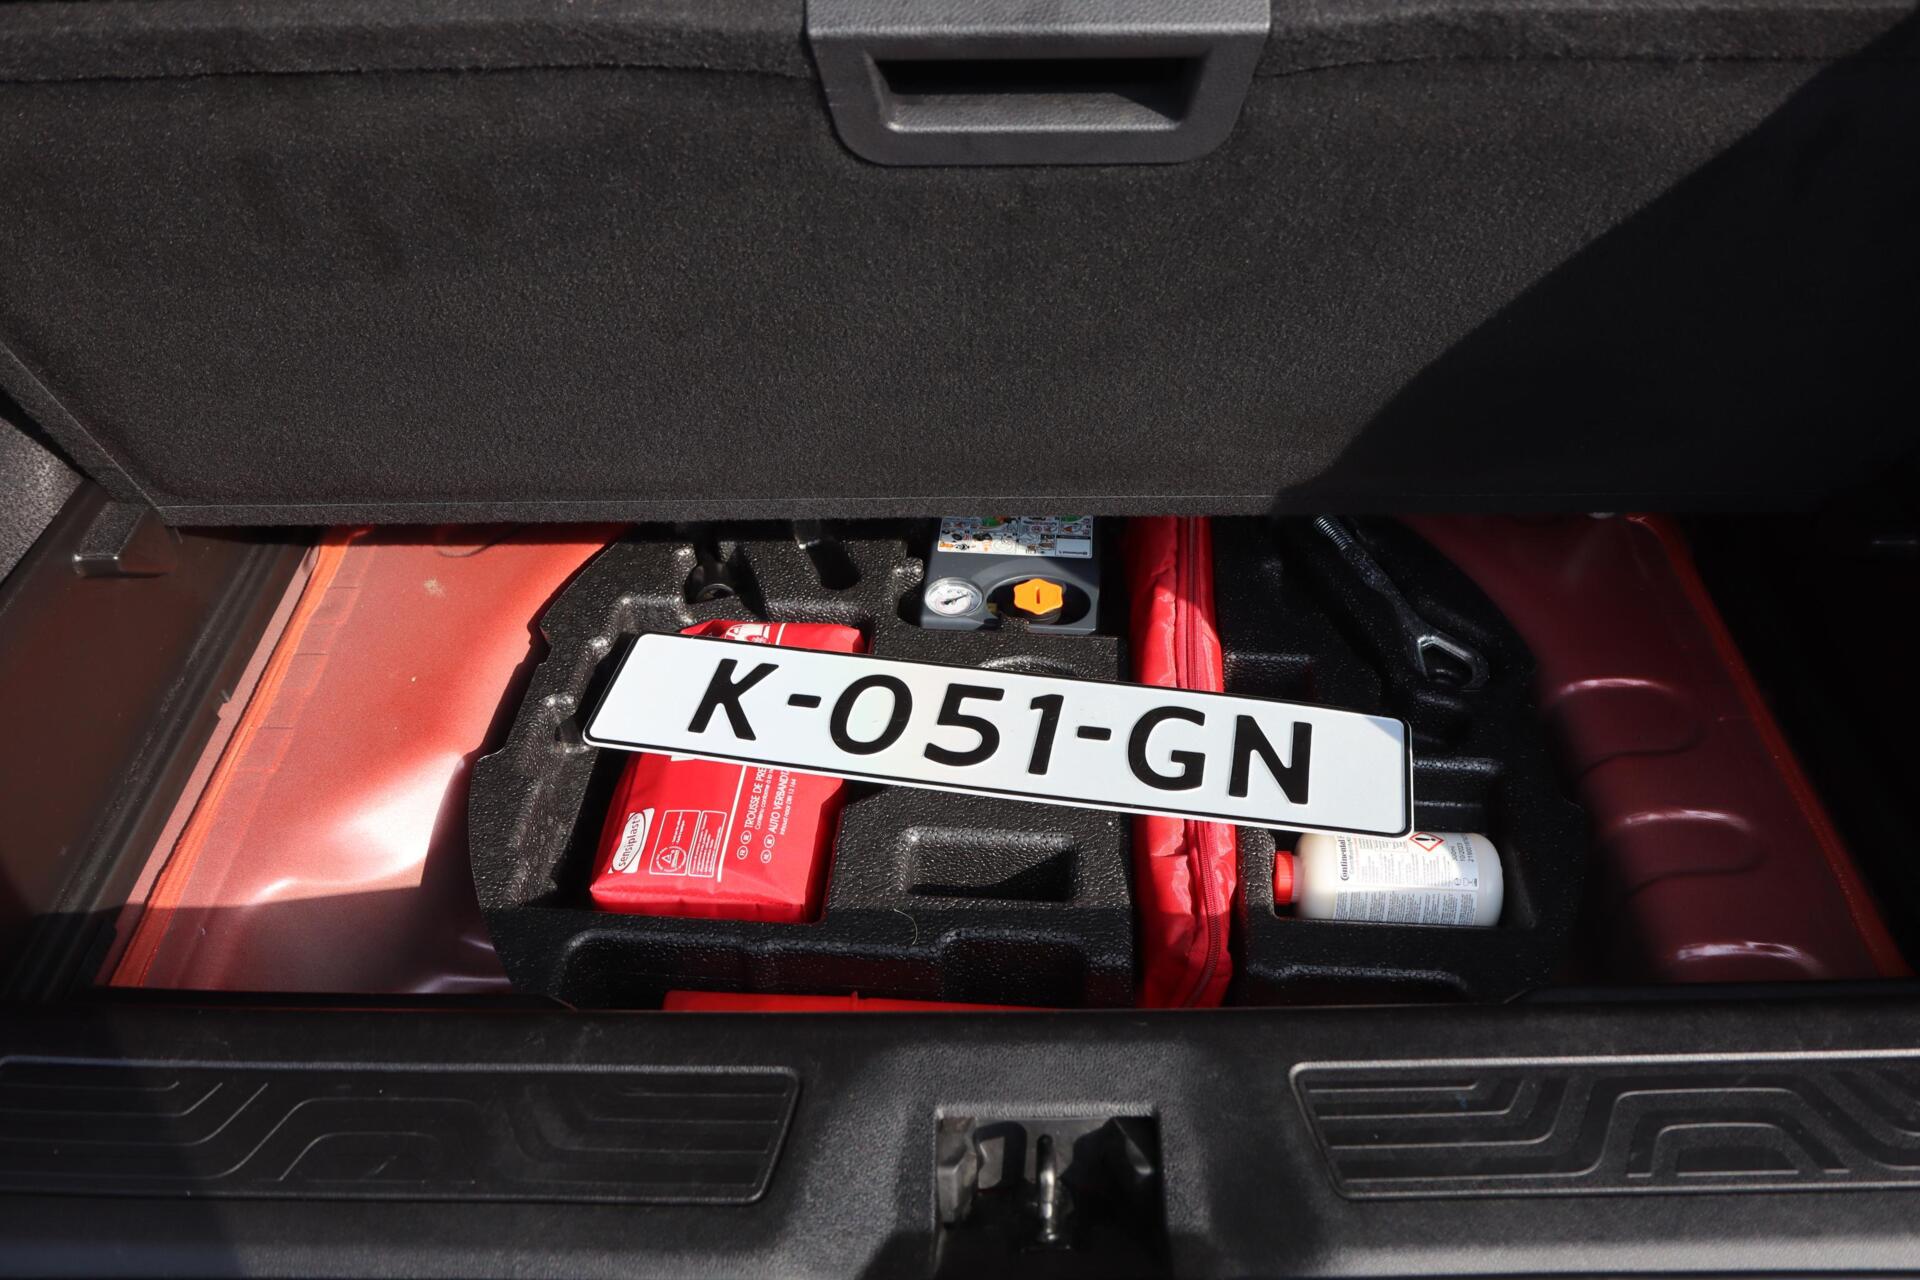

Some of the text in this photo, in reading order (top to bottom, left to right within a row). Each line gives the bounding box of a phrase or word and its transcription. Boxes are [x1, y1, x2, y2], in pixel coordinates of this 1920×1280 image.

[688, 659, 1312, 805] K-051-GN
[744, 795, 760, 829] TROUSSE
[752, 782, 763, 794] DE
[768, 811, 780, 833] AUTO
[1338, 839, 1349, 881] Continental
